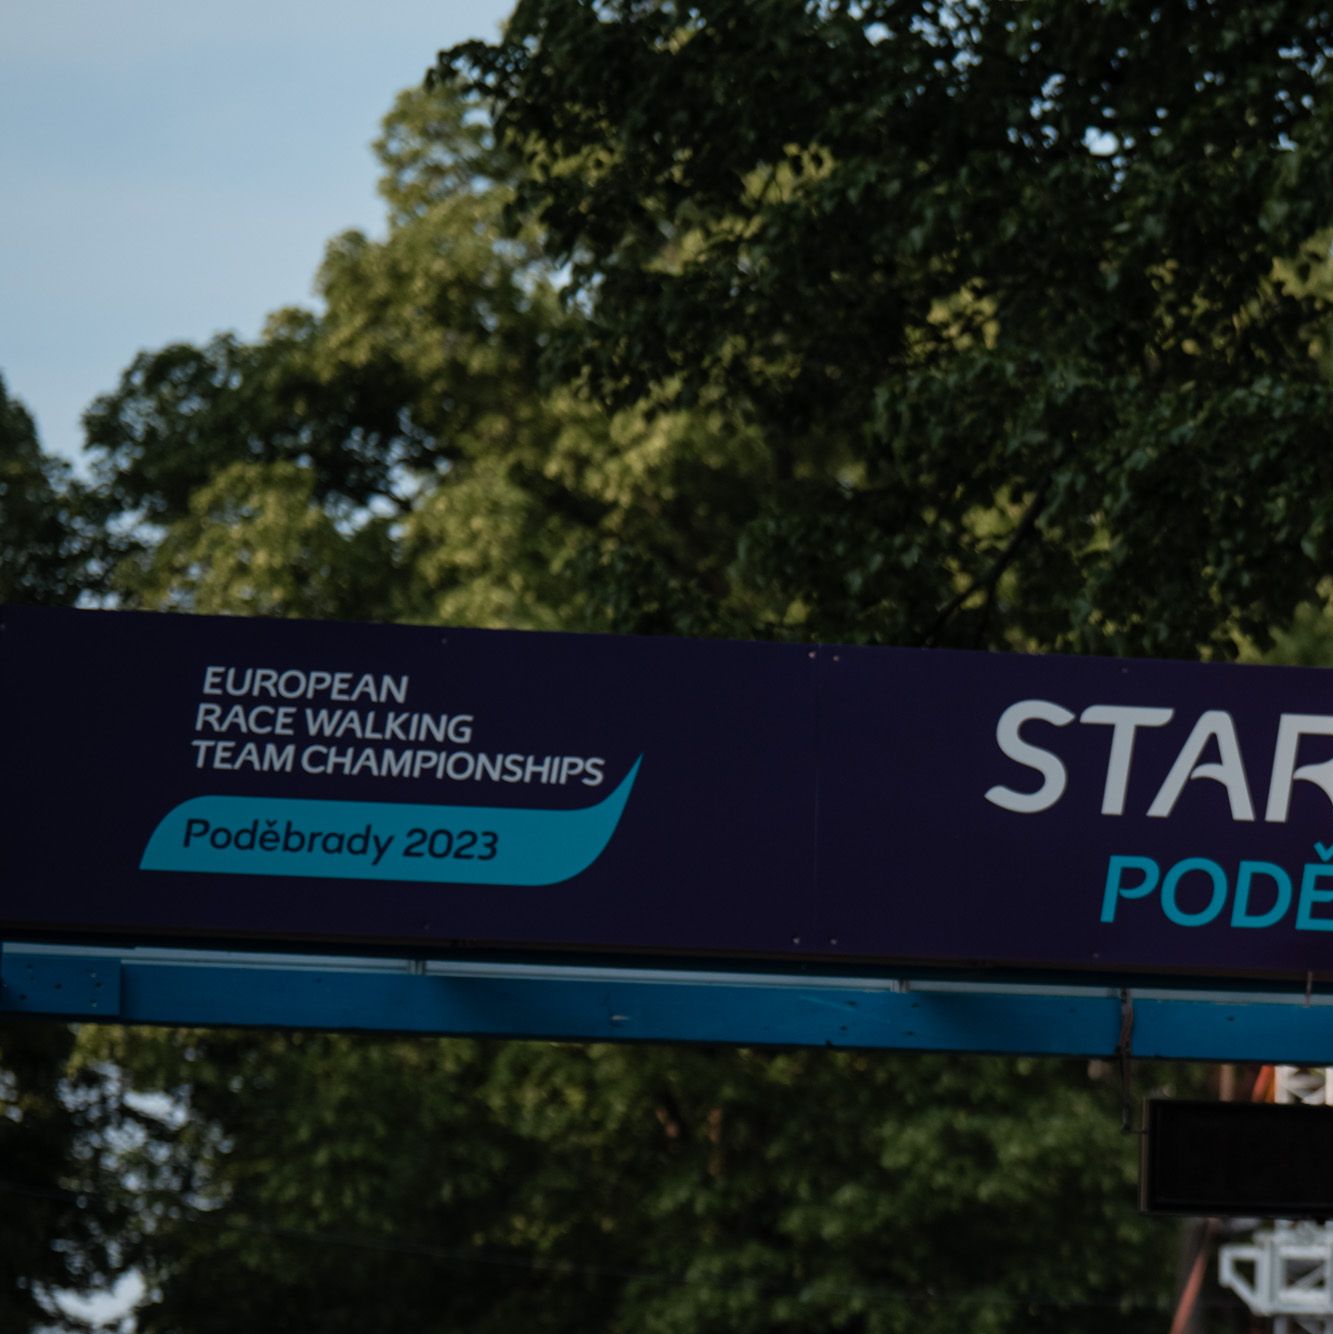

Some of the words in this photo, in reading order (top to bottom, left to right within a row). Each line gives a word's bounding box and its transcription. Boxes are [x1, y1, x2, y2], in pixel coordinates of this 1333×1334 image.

[202, 666, 409, 704] EUROPEAN
[195, 704, 295, 736] RACE
[304, 708, 474, 743] WALKING
[191, 740, 295, 774] TEAM
[301, 746, 605, 786] CHAMPIONSHIPS
[183, 818, 394, 866] Poděbrady
[403, 828, 499, 861] 2023
